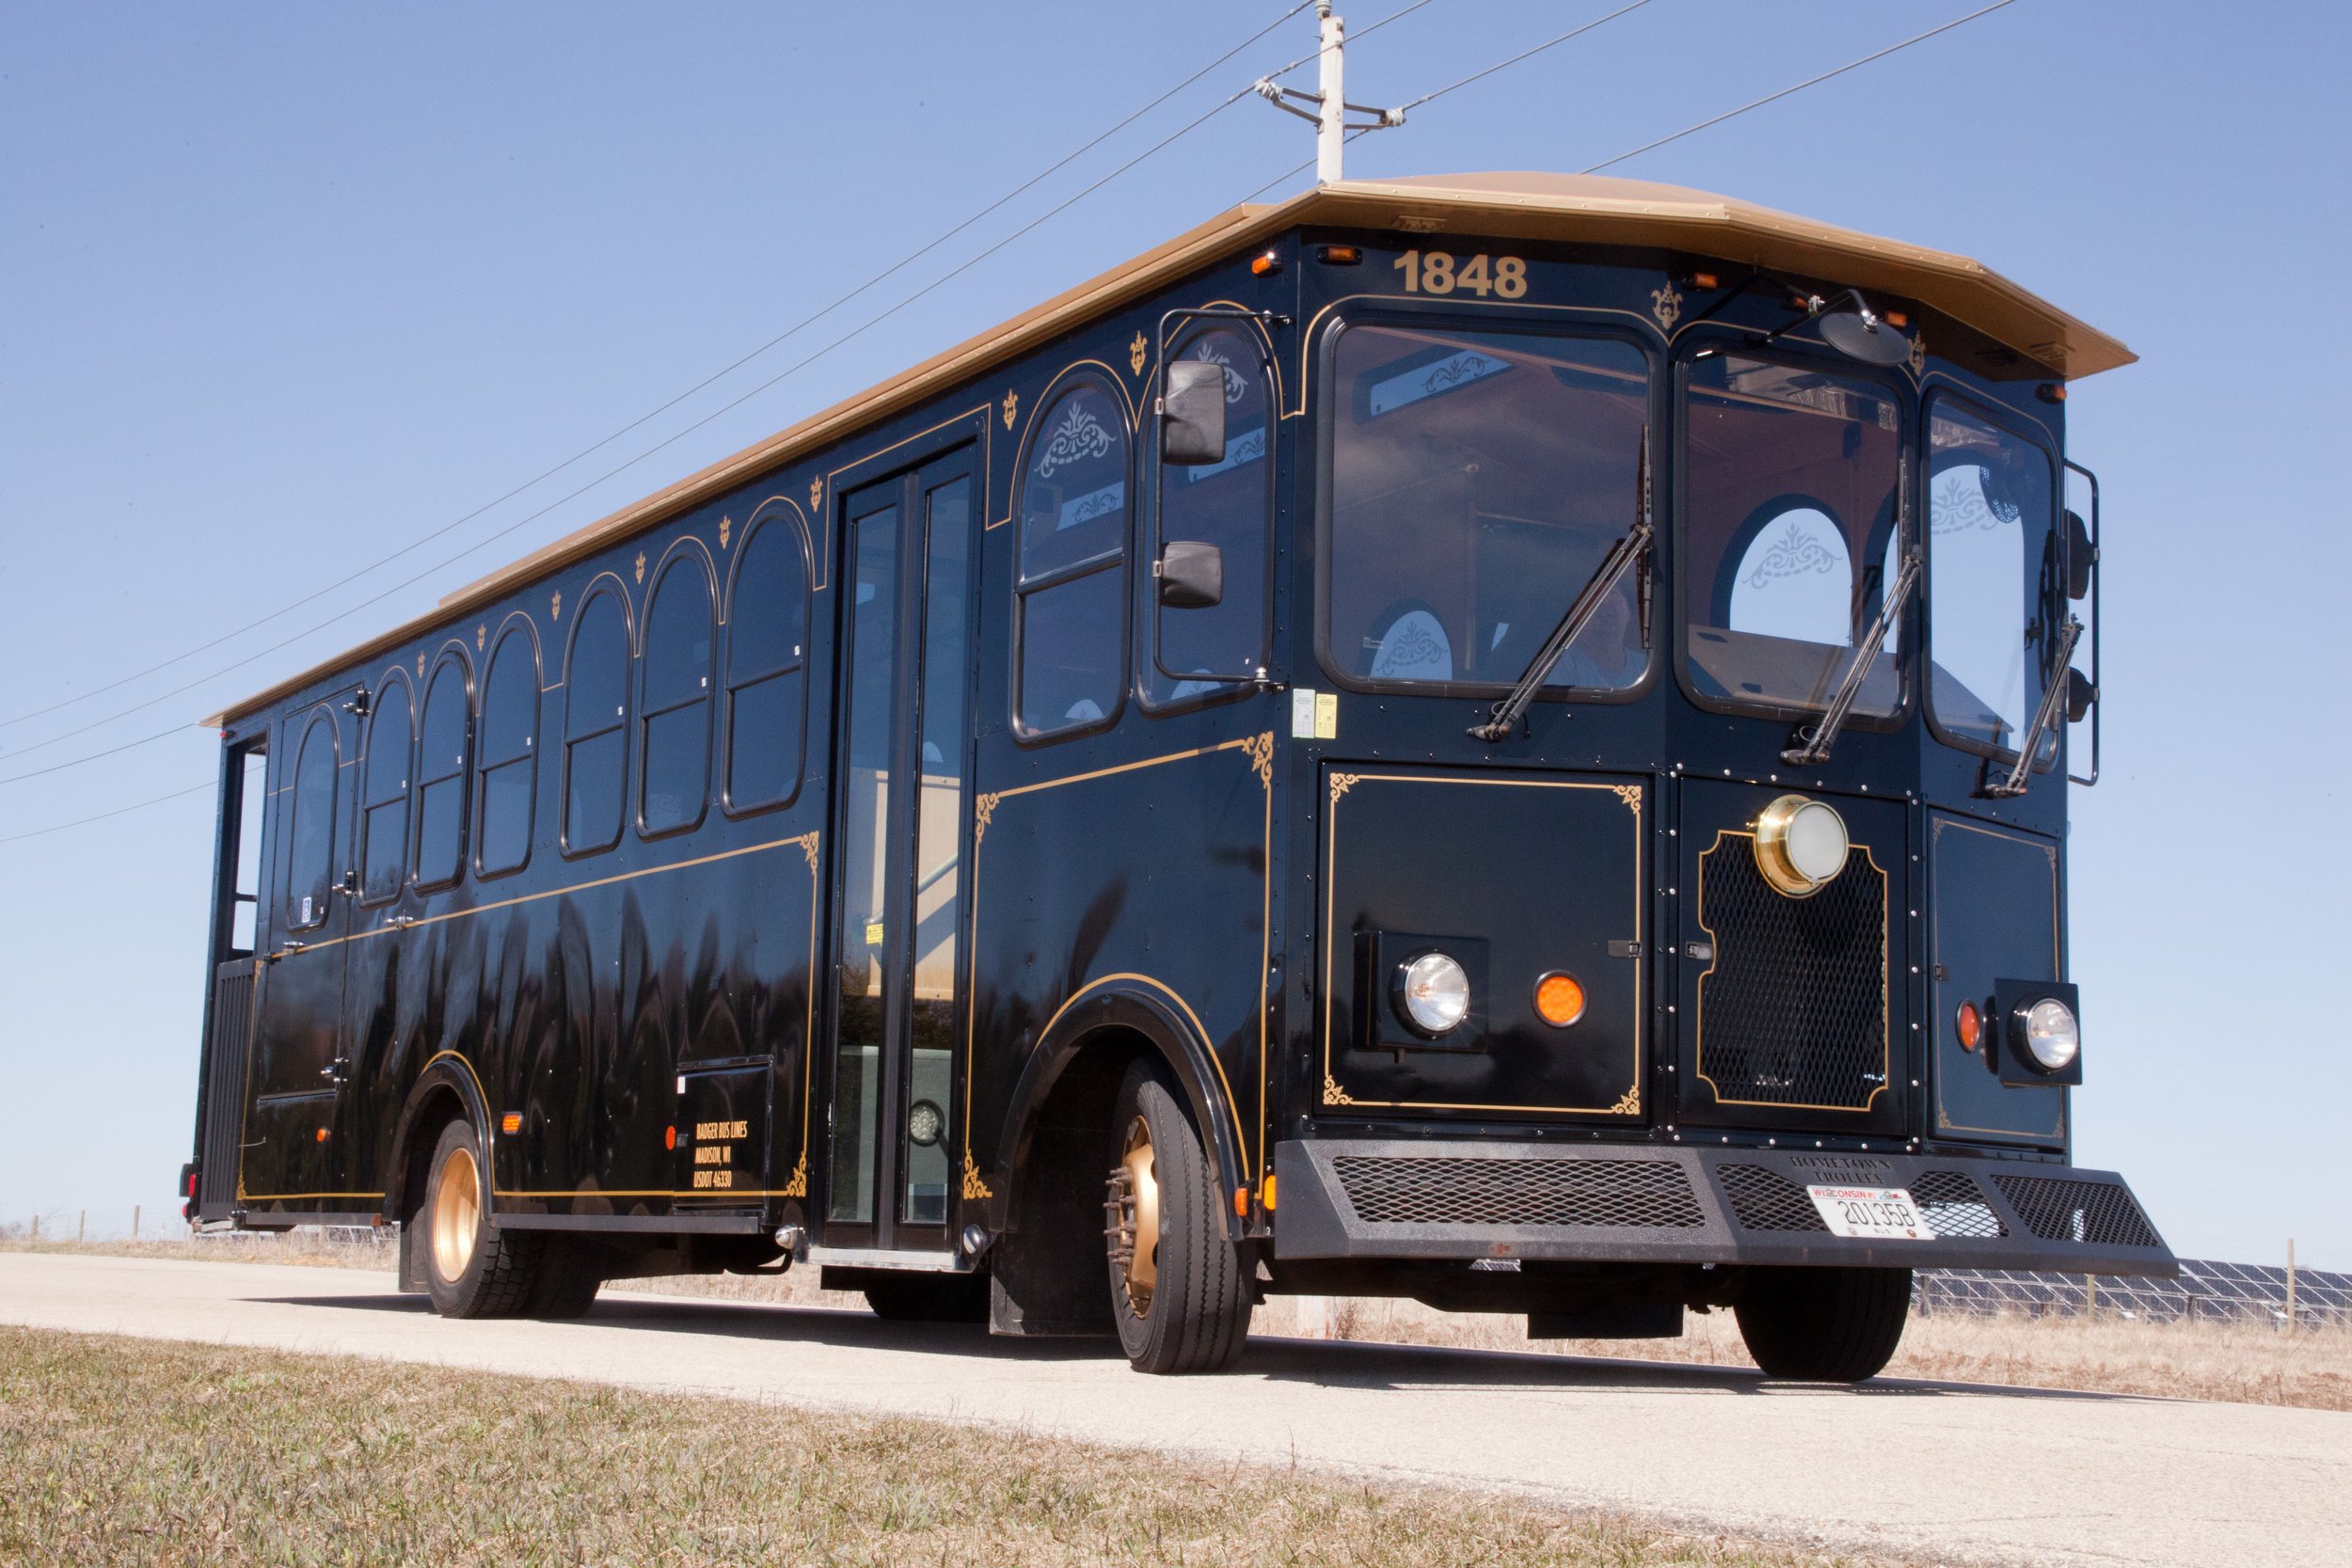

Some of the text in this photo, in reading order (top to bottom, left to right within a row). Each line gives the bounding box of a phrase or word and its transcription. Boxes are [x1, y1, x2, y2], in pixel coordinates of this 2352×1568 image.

[1393, 249, 1528, 299] 1848
[696, 1120, 747, 1139] BADGER BUS LINES
[695, 1146, 731, 1166] MADISON, WI
[1790, 1156, 1891, 1170] HOMETOWN
[694, 1170, 732, 1188] USDOT 46330
[1814, 1172, 1884, 1184] TROLLEY
[1837, 1200, 1915, 1227] 20135B
